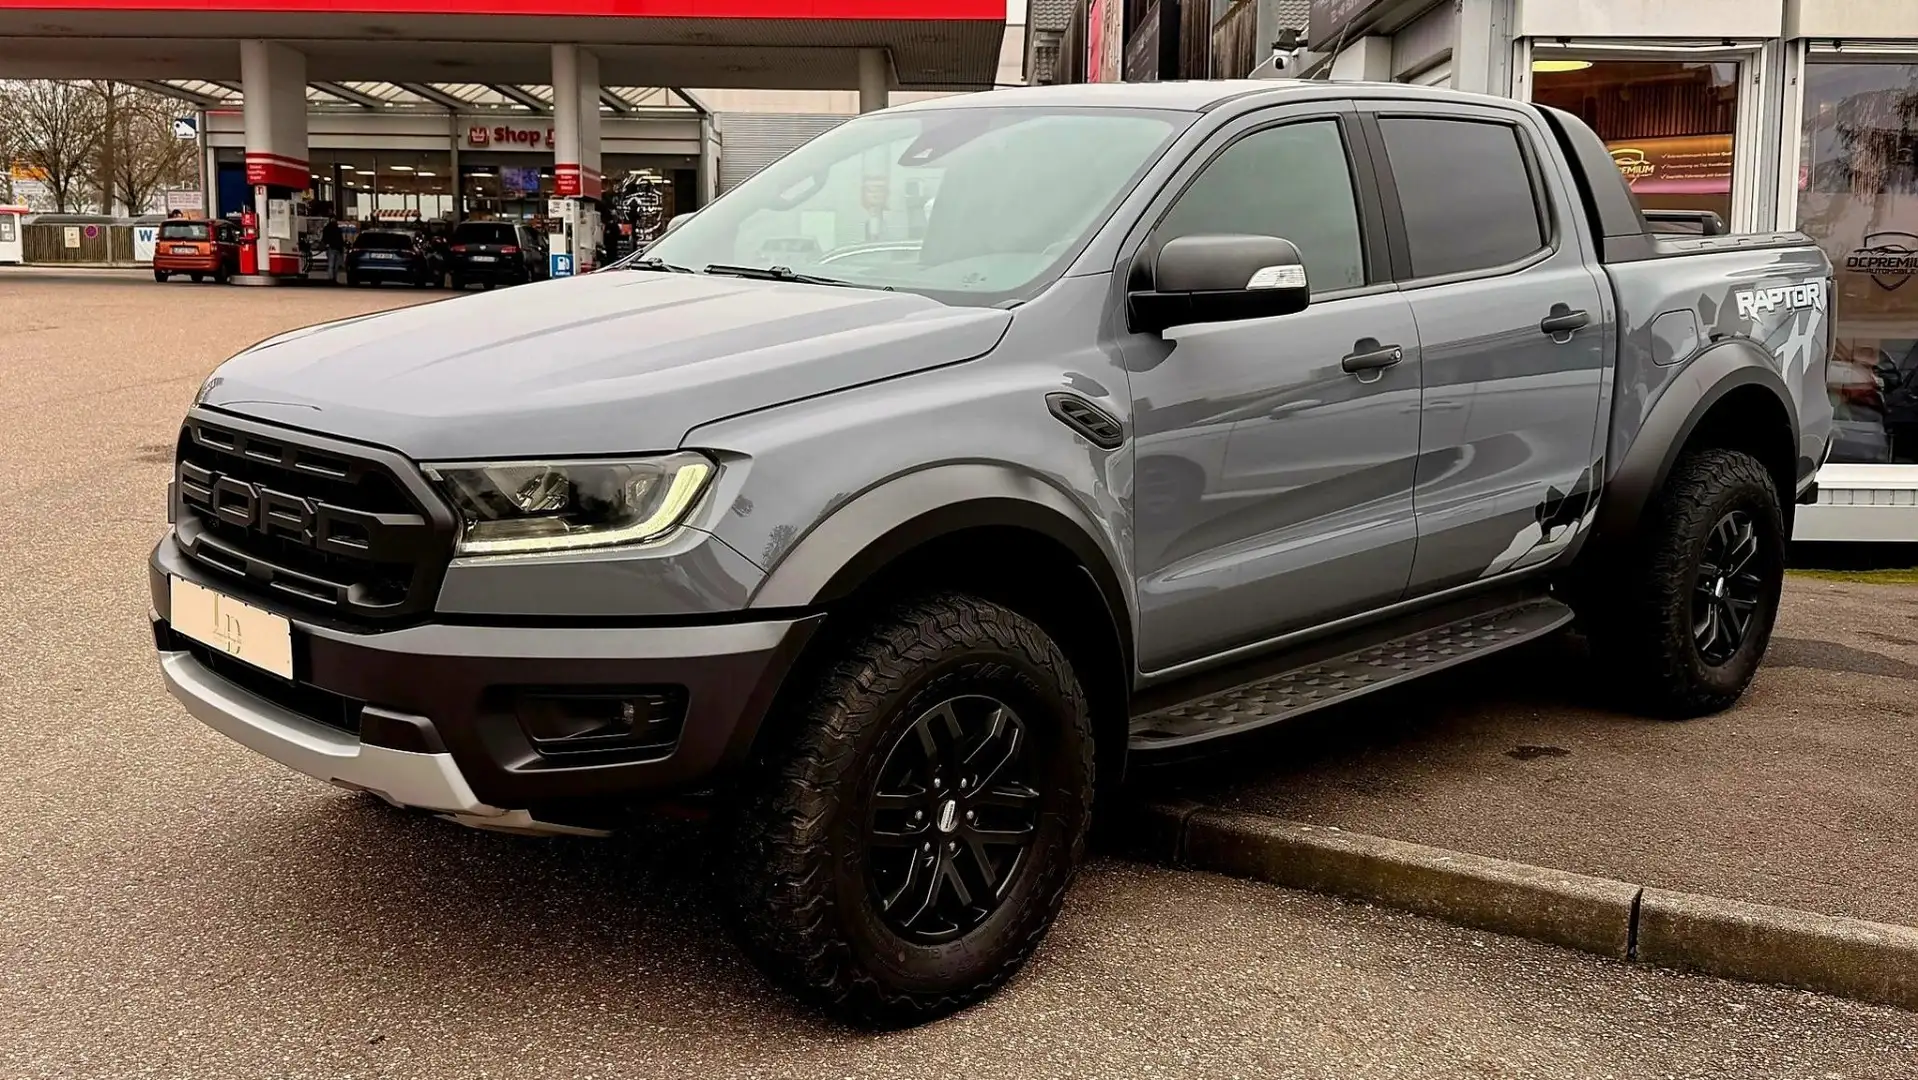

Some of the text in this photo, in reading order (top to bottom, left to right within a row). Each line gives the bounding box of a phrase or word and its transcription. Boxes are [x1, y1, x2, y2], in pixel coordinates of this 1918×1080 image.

[494, 126, 541, 148] Shop
[1619, 164, 1656, 175] EMIUM
[1735, 282, 1825, 325] RAPTOR
[180, 459, 374, 551] FORD
